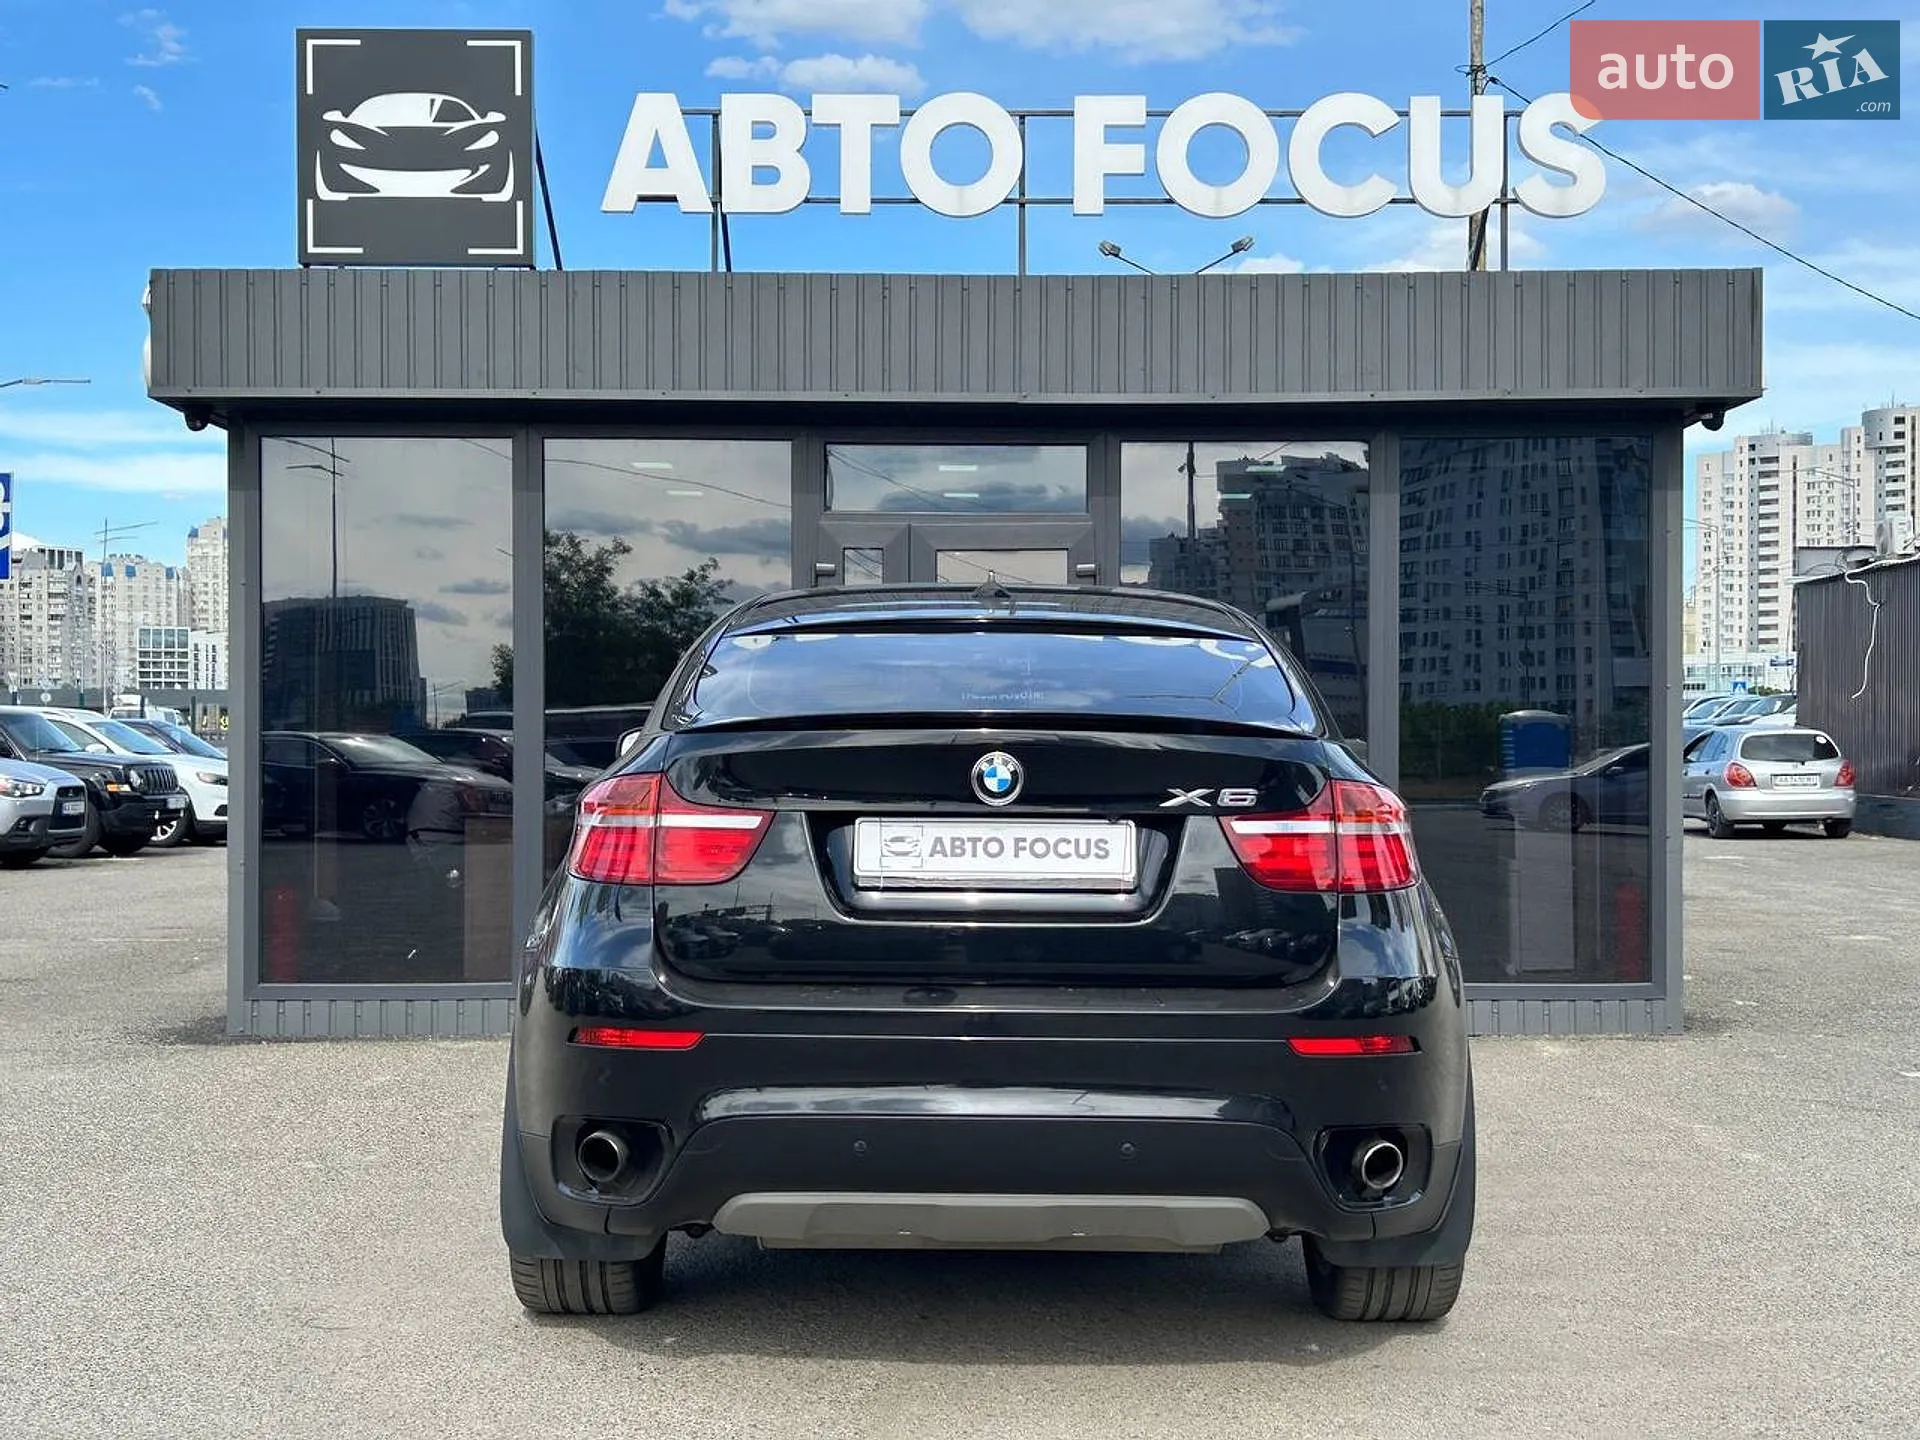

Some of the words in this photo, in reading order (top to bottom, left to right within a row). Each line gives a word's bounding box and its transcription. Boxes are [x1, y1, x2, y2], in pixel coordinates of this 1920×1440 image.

[601, 92, 1023, 217] АВТО
[1073, 92, 1606, 218] FOCUS
[1159, 788, 1258, 806] X6
[929, 836, 1004, 859] АВТО
[1013, 837, 1110, 860] FOCUS
